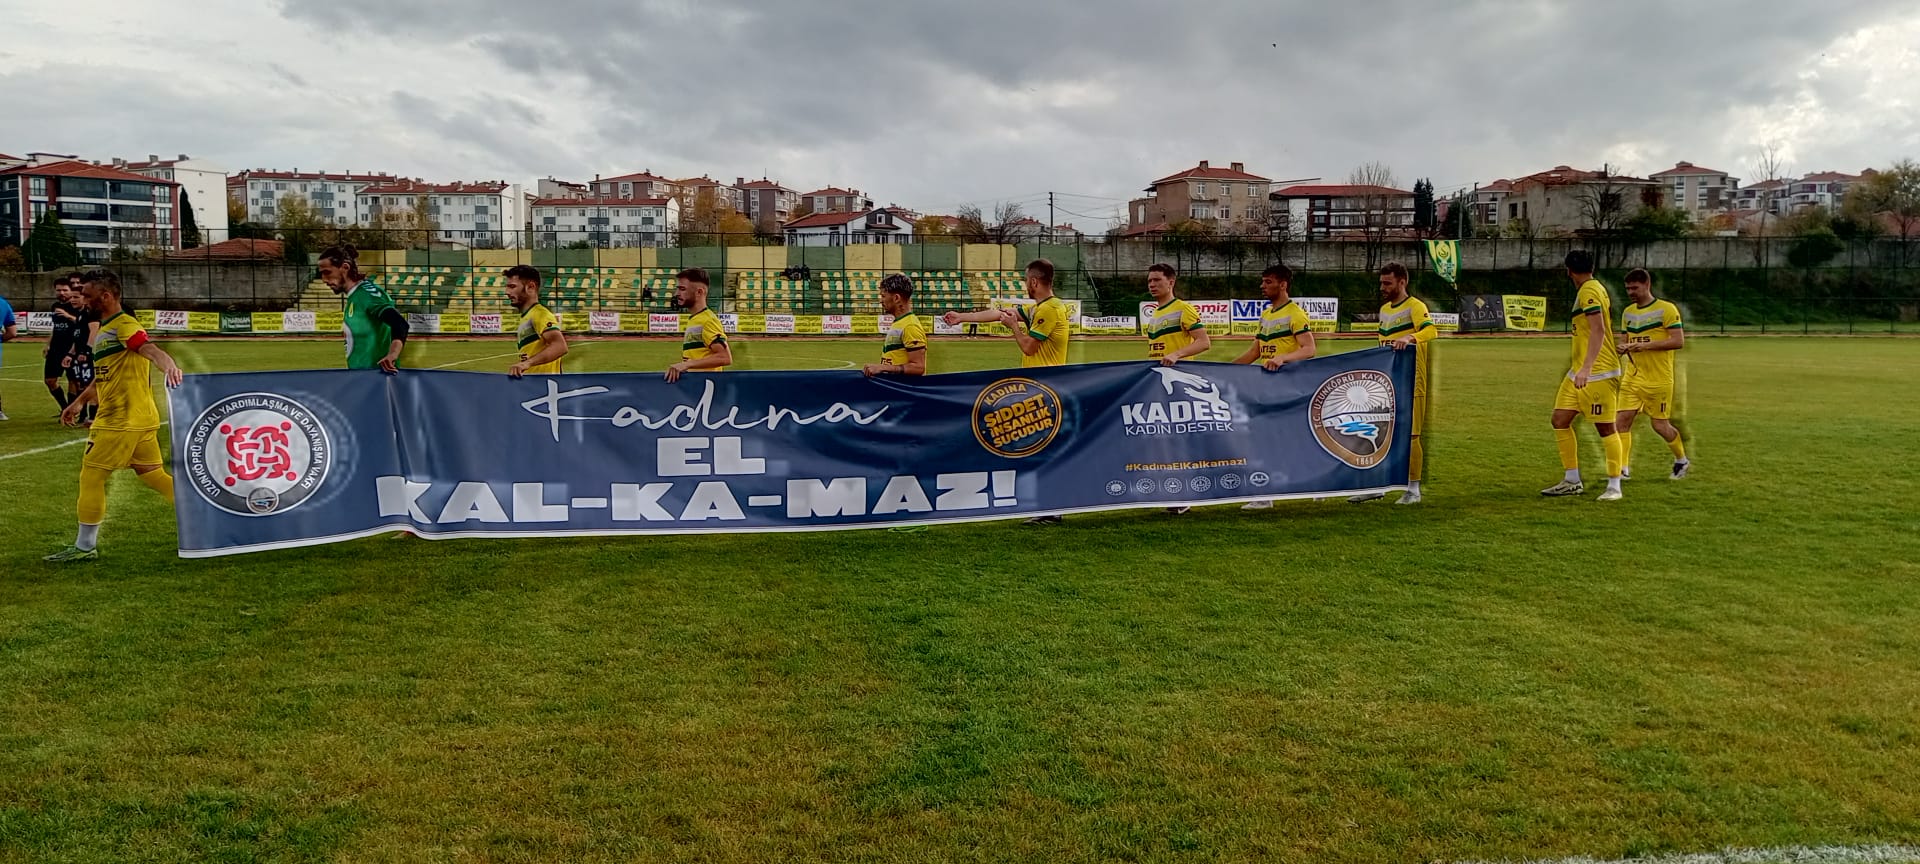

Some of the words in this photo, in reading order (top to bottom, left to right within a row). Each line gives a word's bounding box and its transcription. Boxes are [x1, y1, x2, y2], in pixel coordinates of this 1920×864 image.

[983, 384, 1027, 406] KADINA
[1314, 374, 1355, 410] UZUNKÖPRÜ
[219, 398, 290, 415] YARDIMLAŞMA
[290, 407, 302, 420] VE
[521, 379, 889, 442] Kadına
[1121, 400, 1232, 425] KADES
[1591, 404, 1602, 415] 10
[195, 412, 221, 443] SOSYAL
[1125, 424, 1172, 436] KADIN
[1176, 421, 1234, 434] DESTEK
[86, 441, 94, 455] 7
[300, 417, 325, 468] DAYANIŞMA
[656, 436, 766, 477] EL
[191, 445, 221, 497] UZUNKÖPRÜ
[301, 466, 322, 490] VAKFI
[376, 469, 1018, 524] KAL-KA-MAZ!
